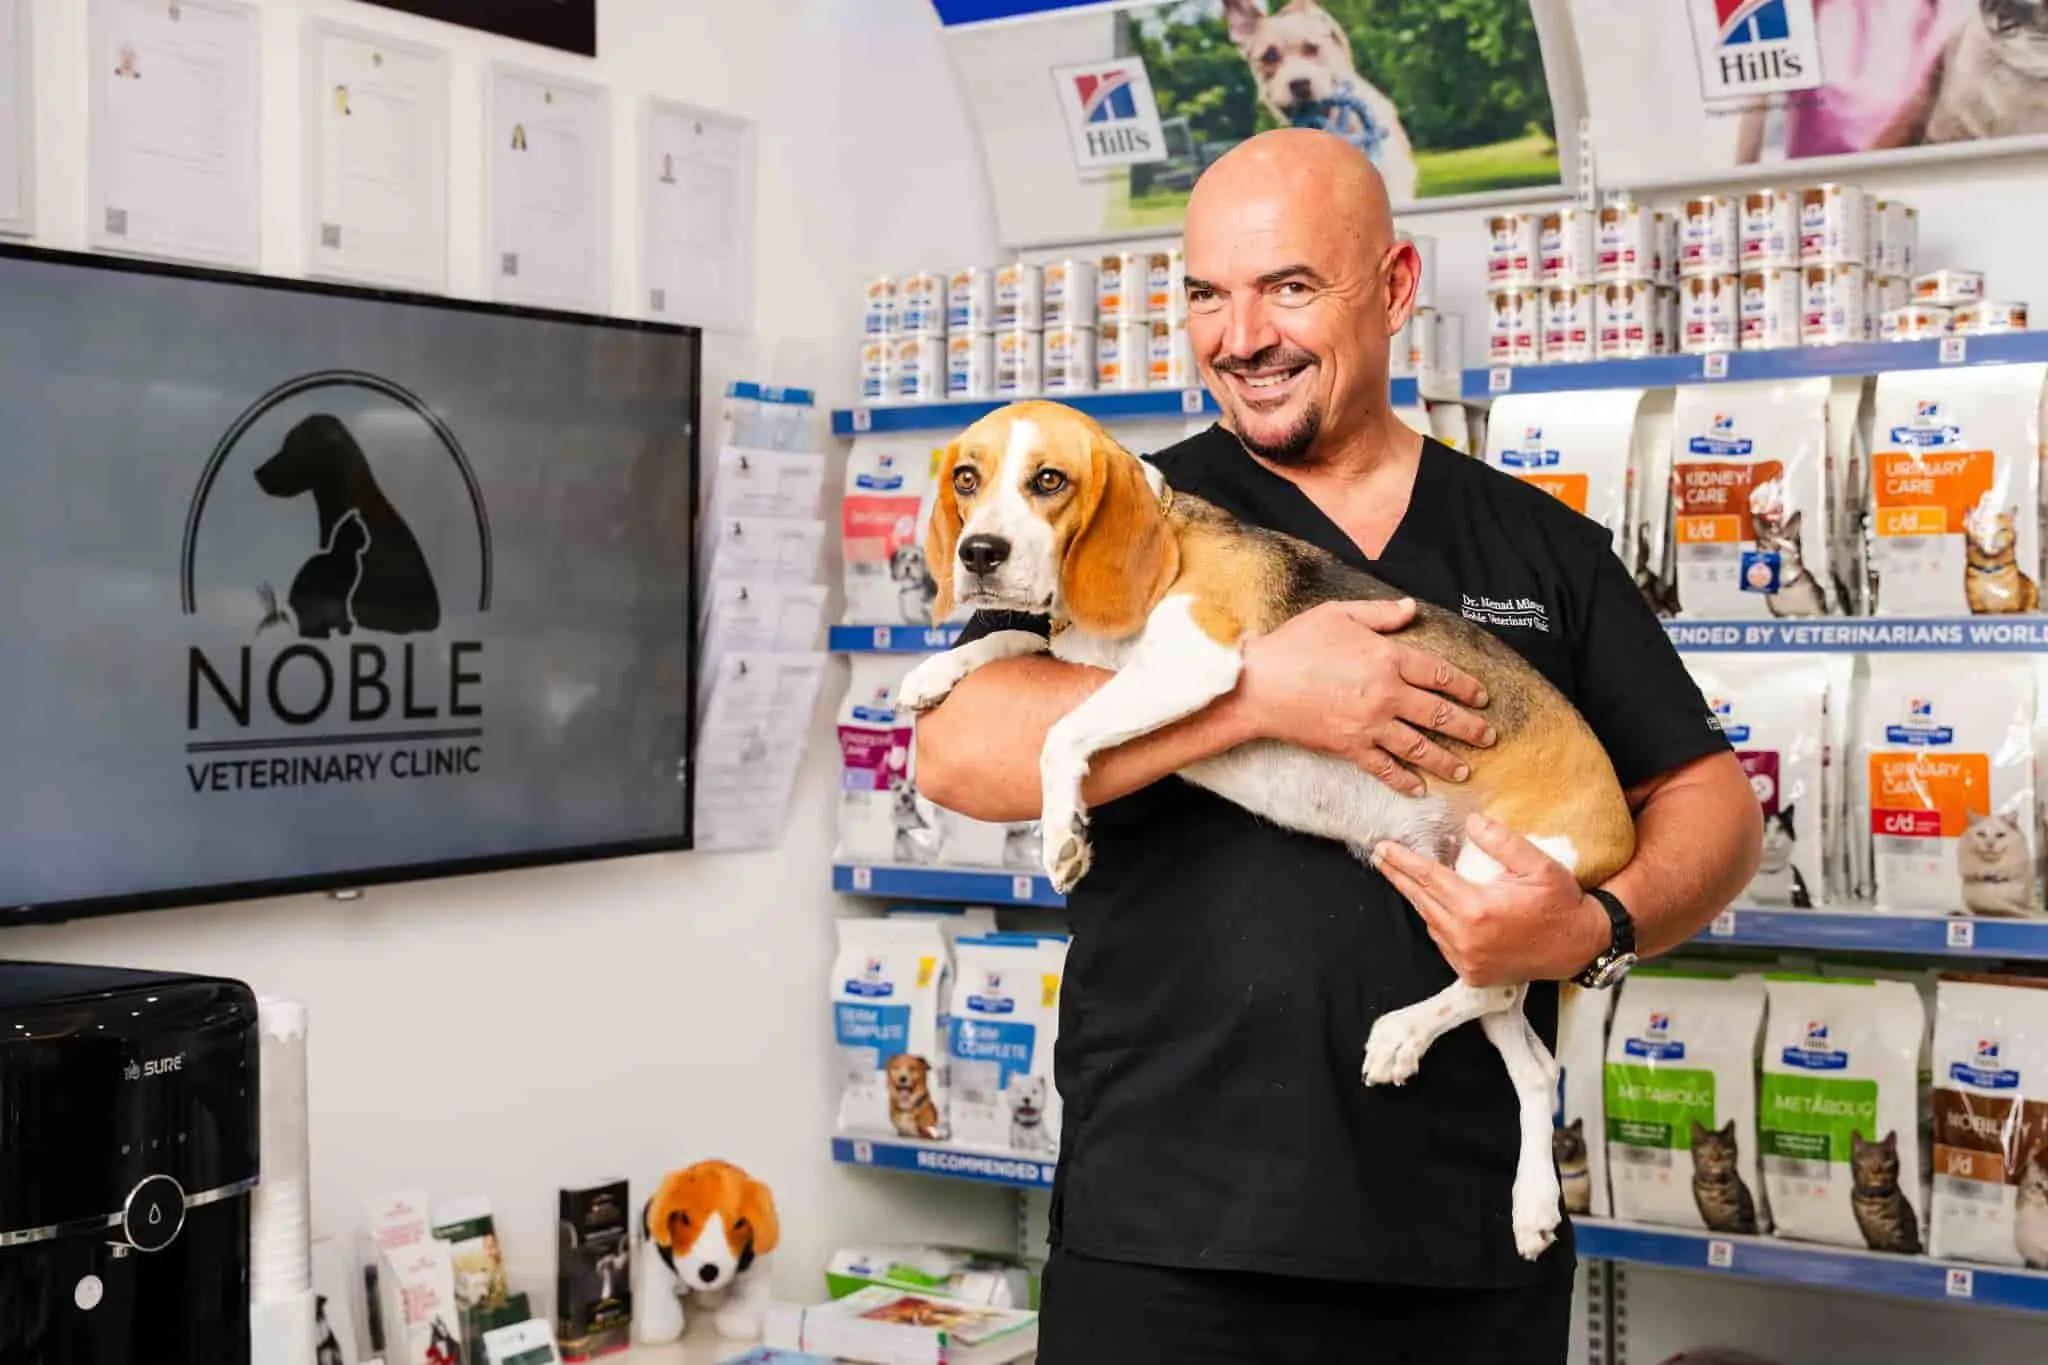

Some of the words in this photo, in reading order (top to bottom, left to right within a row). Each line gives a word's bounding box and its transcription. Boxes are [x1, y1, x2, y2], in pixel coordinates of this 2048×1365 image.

[1720, 48, 1803, 84] Hill's
[1086, 126, 1152, 157] Hill's
[1885, 455, 1968, 478] URINARY
[1684, 470, 1748, 488] KIDNEY
[1885, 478, 1937, 496] CARE
[1685, 486, 1730, 505] CARE
[1462, 593, 1479, 607] Dr.
[1745, 627, 1774, 644] BY
[1780, 626, 1963, 645] VETERINARIANS
[187, 641, 484, 730] NOBLE
[186, 752, 382, 792] VETERINARY
[389, 746, 482, 779] CLINIC
[1884, 813, 1915, 832] c/d
[144, 1056, 182, 1076] SURE
[1618, 1083, 1711, 1107] METABOLIC
[1774, 1094, 1874, 1117] METABOLIC
[917, 1151, 1040, 1180] RECOMMENDED
